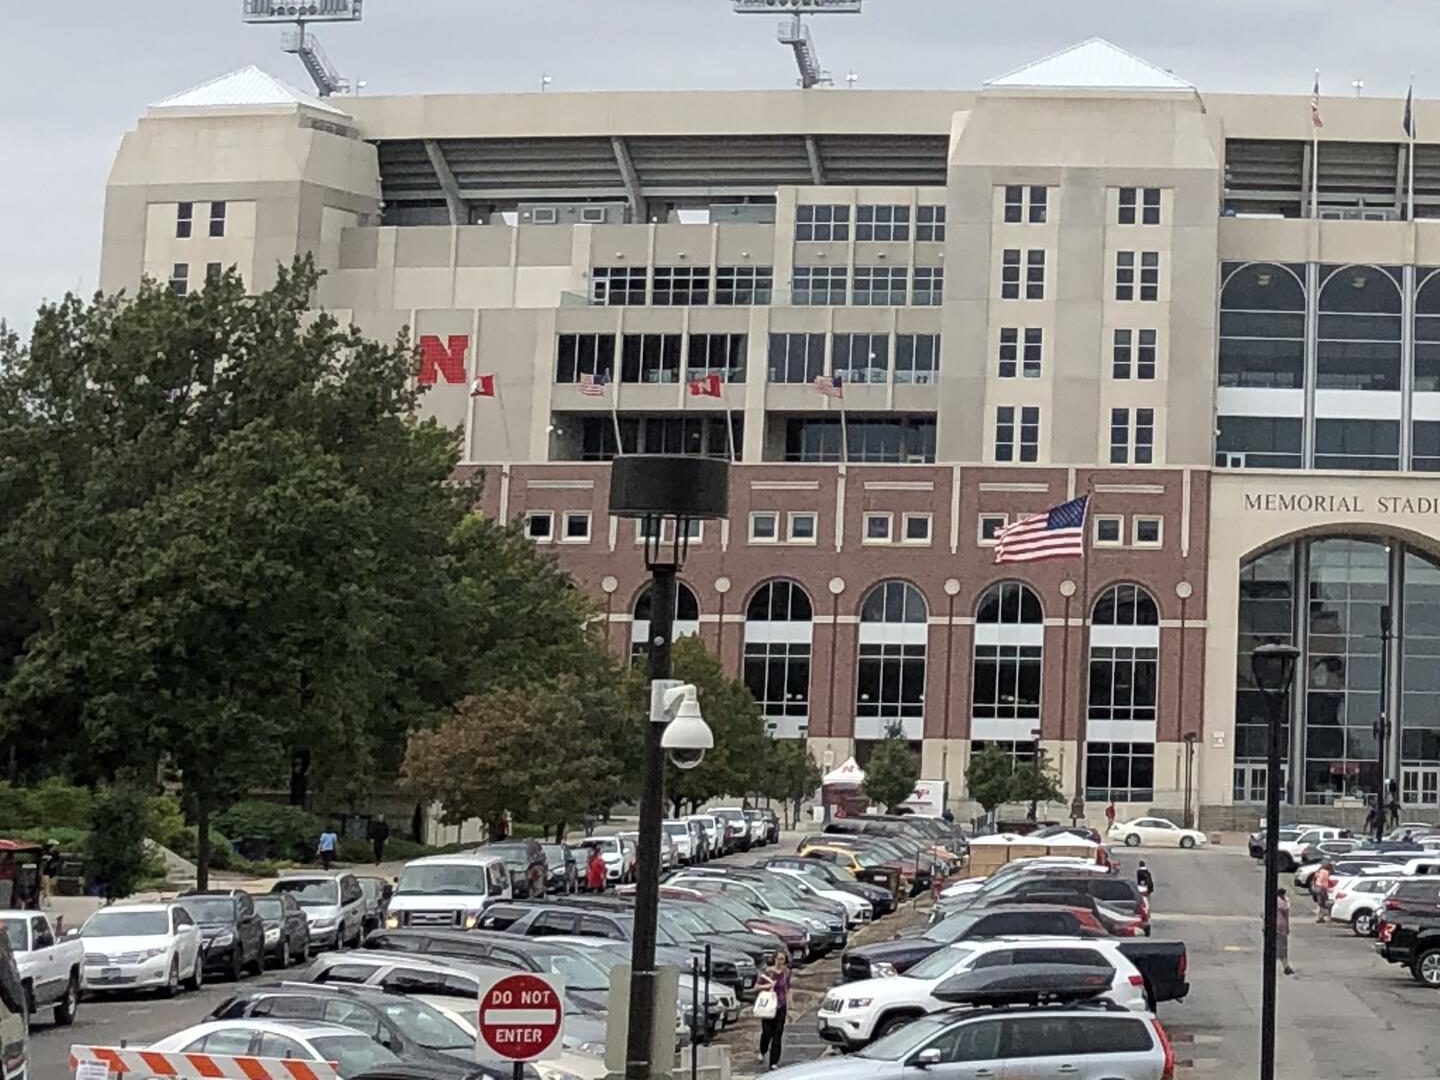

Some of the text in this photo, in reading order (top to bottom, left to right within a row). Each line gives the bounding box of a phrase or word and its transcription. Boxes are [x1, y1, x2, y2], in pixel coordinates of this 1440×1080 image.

[417, 335, 468, 383] N
[1244, 494, 1364, 513] MEMORIAL
[492, 990, 551, 1005] DO NOT
[495, 1028, 542, 1043] ENTER
